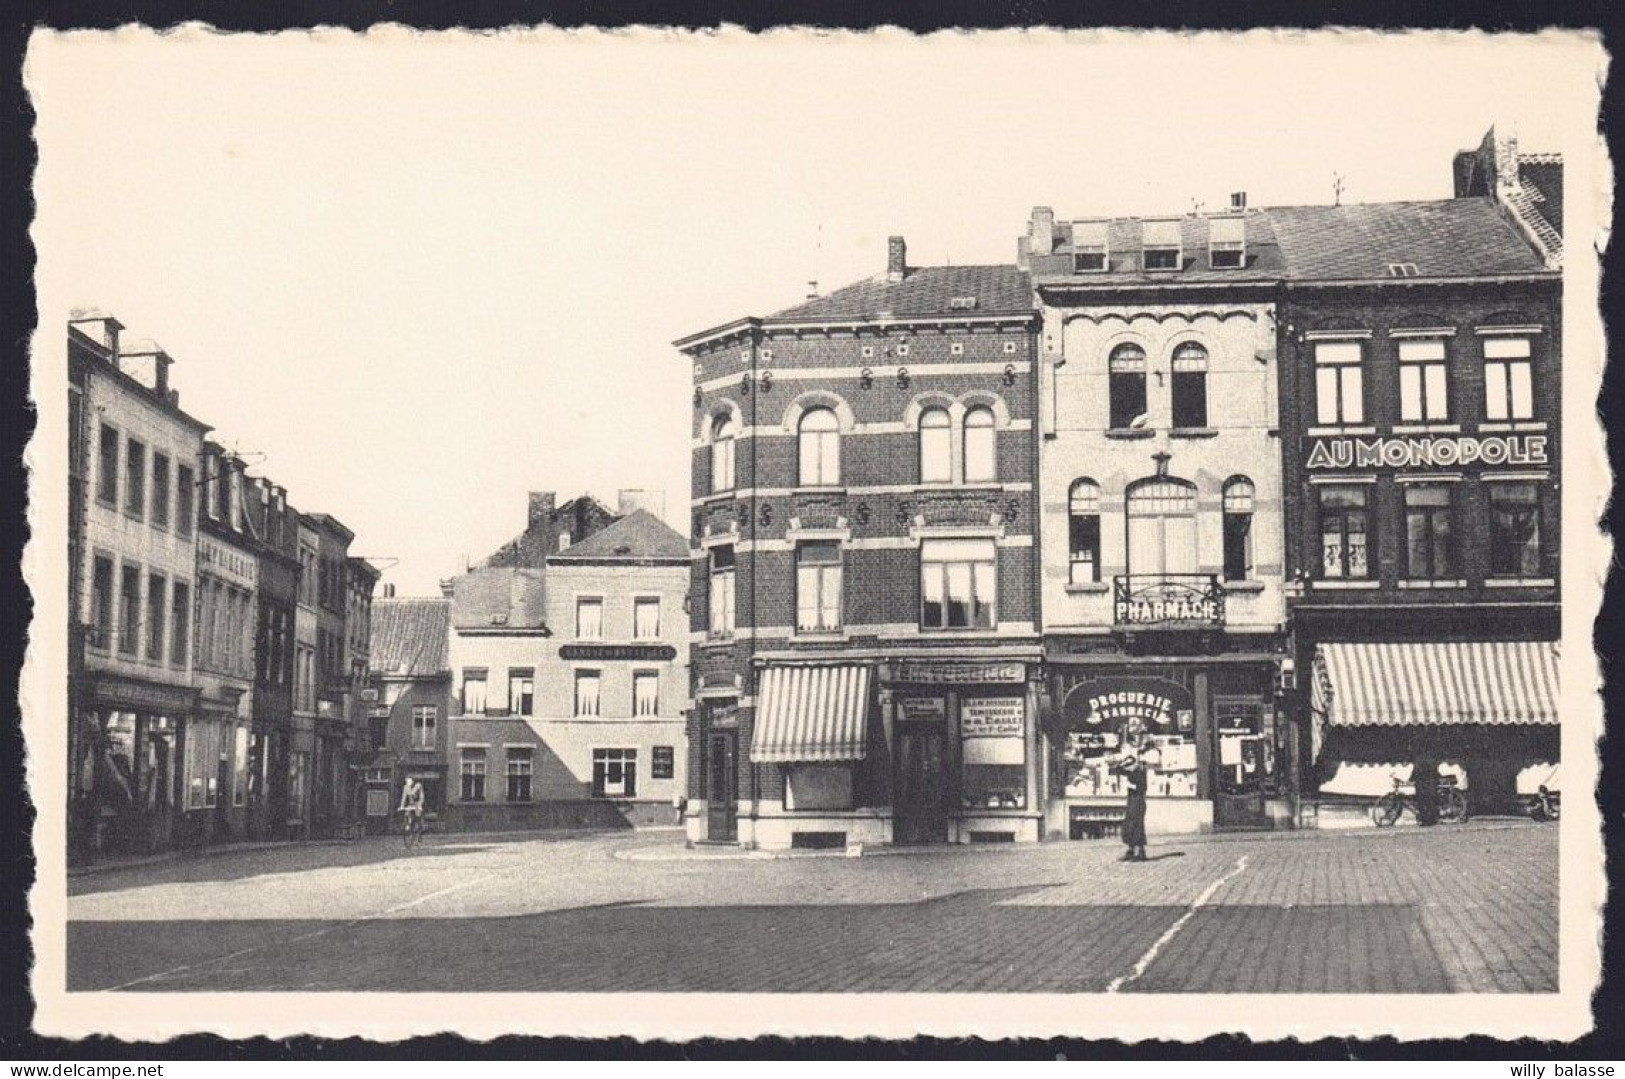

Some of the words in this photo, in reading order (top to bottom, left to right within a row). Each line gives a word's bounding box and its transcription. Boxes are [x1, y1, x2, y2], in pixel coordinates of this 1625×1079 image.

[1306, 439, 1353, 468] AU
[1355, 436, 1548, 467] MONOPOLE
[1116, 601, 1218, 621] PHARMACIE
[1089, 692, 1172, 711] DROGUERIE
